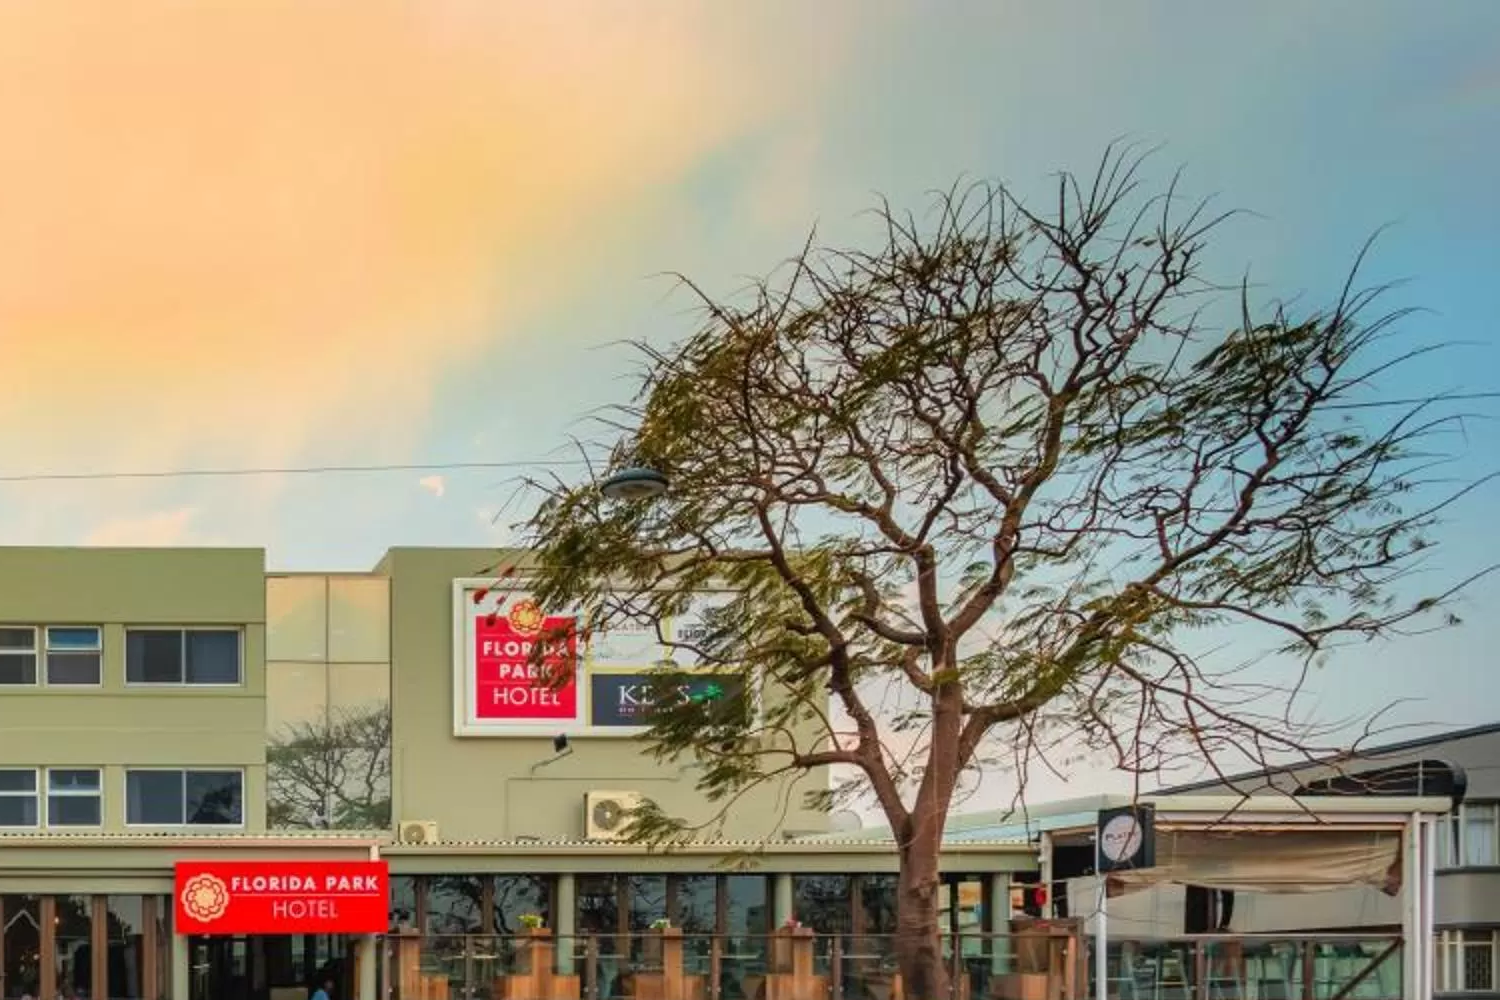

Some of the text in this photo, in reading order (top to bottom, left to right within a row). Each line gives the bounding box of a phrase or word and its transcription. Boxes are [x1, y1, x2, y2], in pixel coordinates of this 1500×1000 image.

[483, 641, 569, 657] FLORDA
[493, 687, 561, 705] HOTEL
[618, 685, 690, 705] KES
[231, 876, 379, 892] FLORIDA PARK
[272, 901, 339, 919] HOTEL
